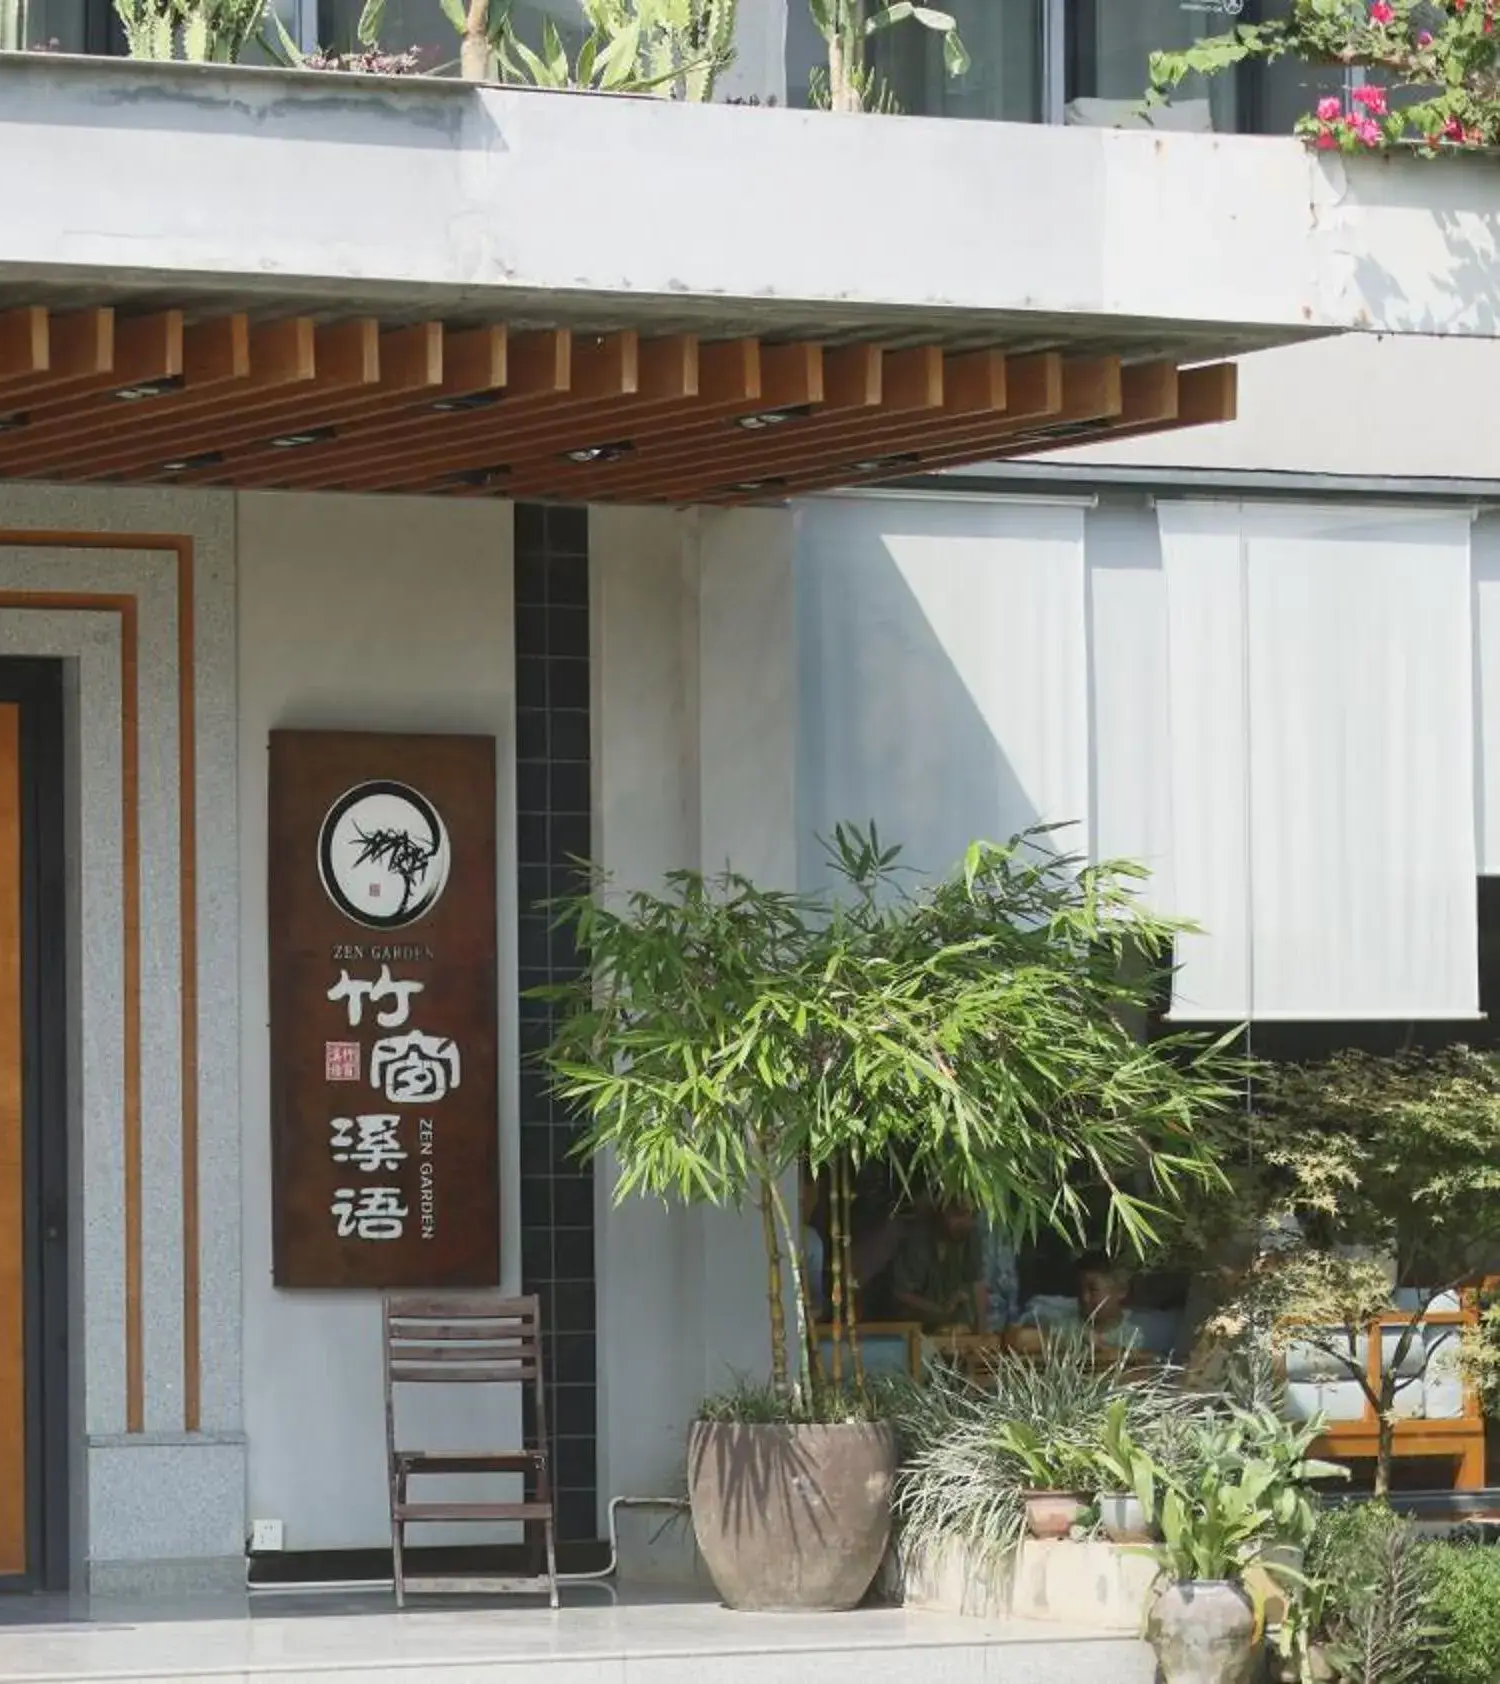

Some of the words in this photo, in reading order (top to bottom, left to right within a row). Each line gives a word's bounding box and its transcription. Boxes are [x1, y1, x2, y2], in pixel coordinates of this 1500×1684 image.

[333, 944, 363, 960] ZEN
[371, 944, 435, 961] GARDEN
[419, 1119, 433, 1156] ZEN
[419, 1162, 435, 1240] GARDEN
